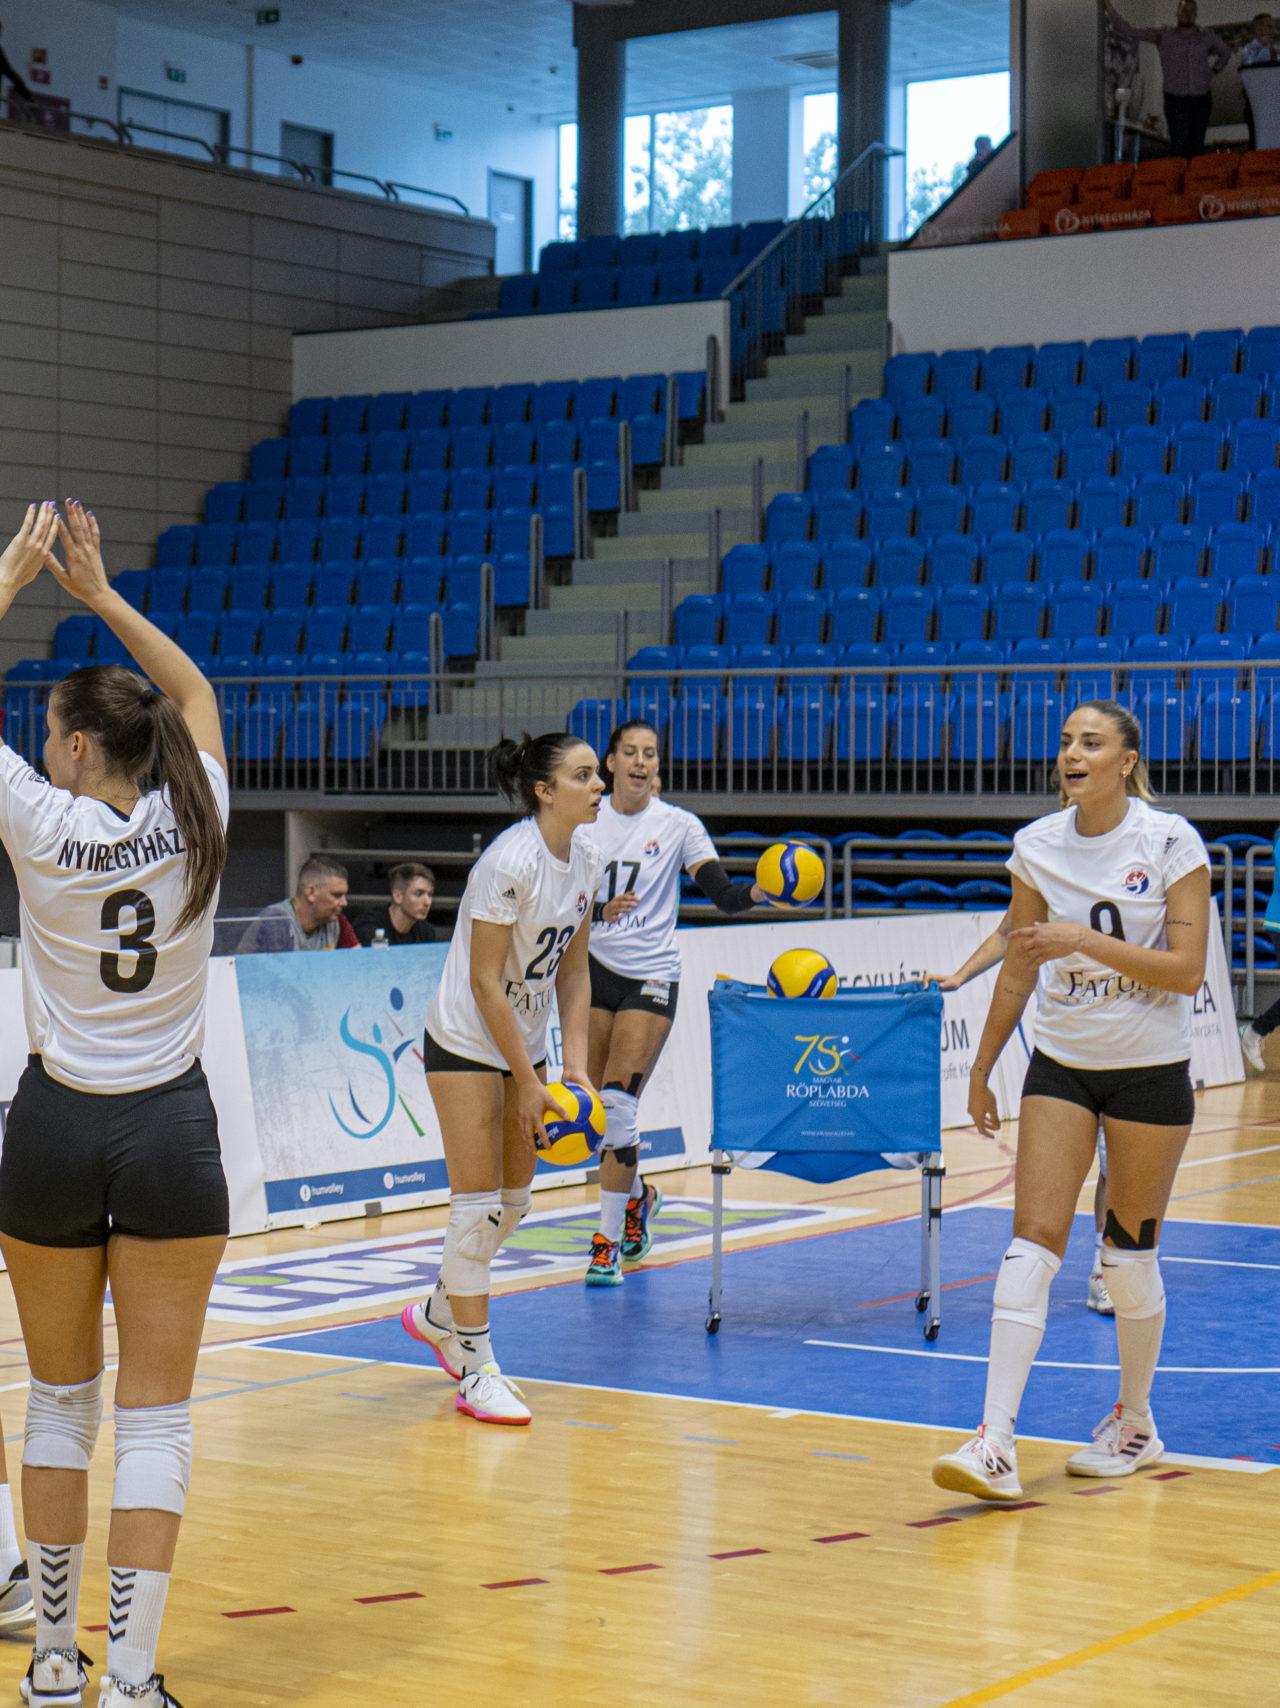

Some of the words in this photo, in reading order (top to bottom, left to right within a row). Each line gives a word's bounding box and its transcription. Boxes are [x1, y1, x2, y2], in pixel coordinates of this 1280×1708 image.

[604, 860, 641, 902] 17
[100, 889, 158, 993] 3
[525, 925, 575, 980] 23
[1066, 969, 1150, 997] FATU
[794, 1034, 841, 1075] 75
[786, 1082, 870, 1098] RÖPLABDA
